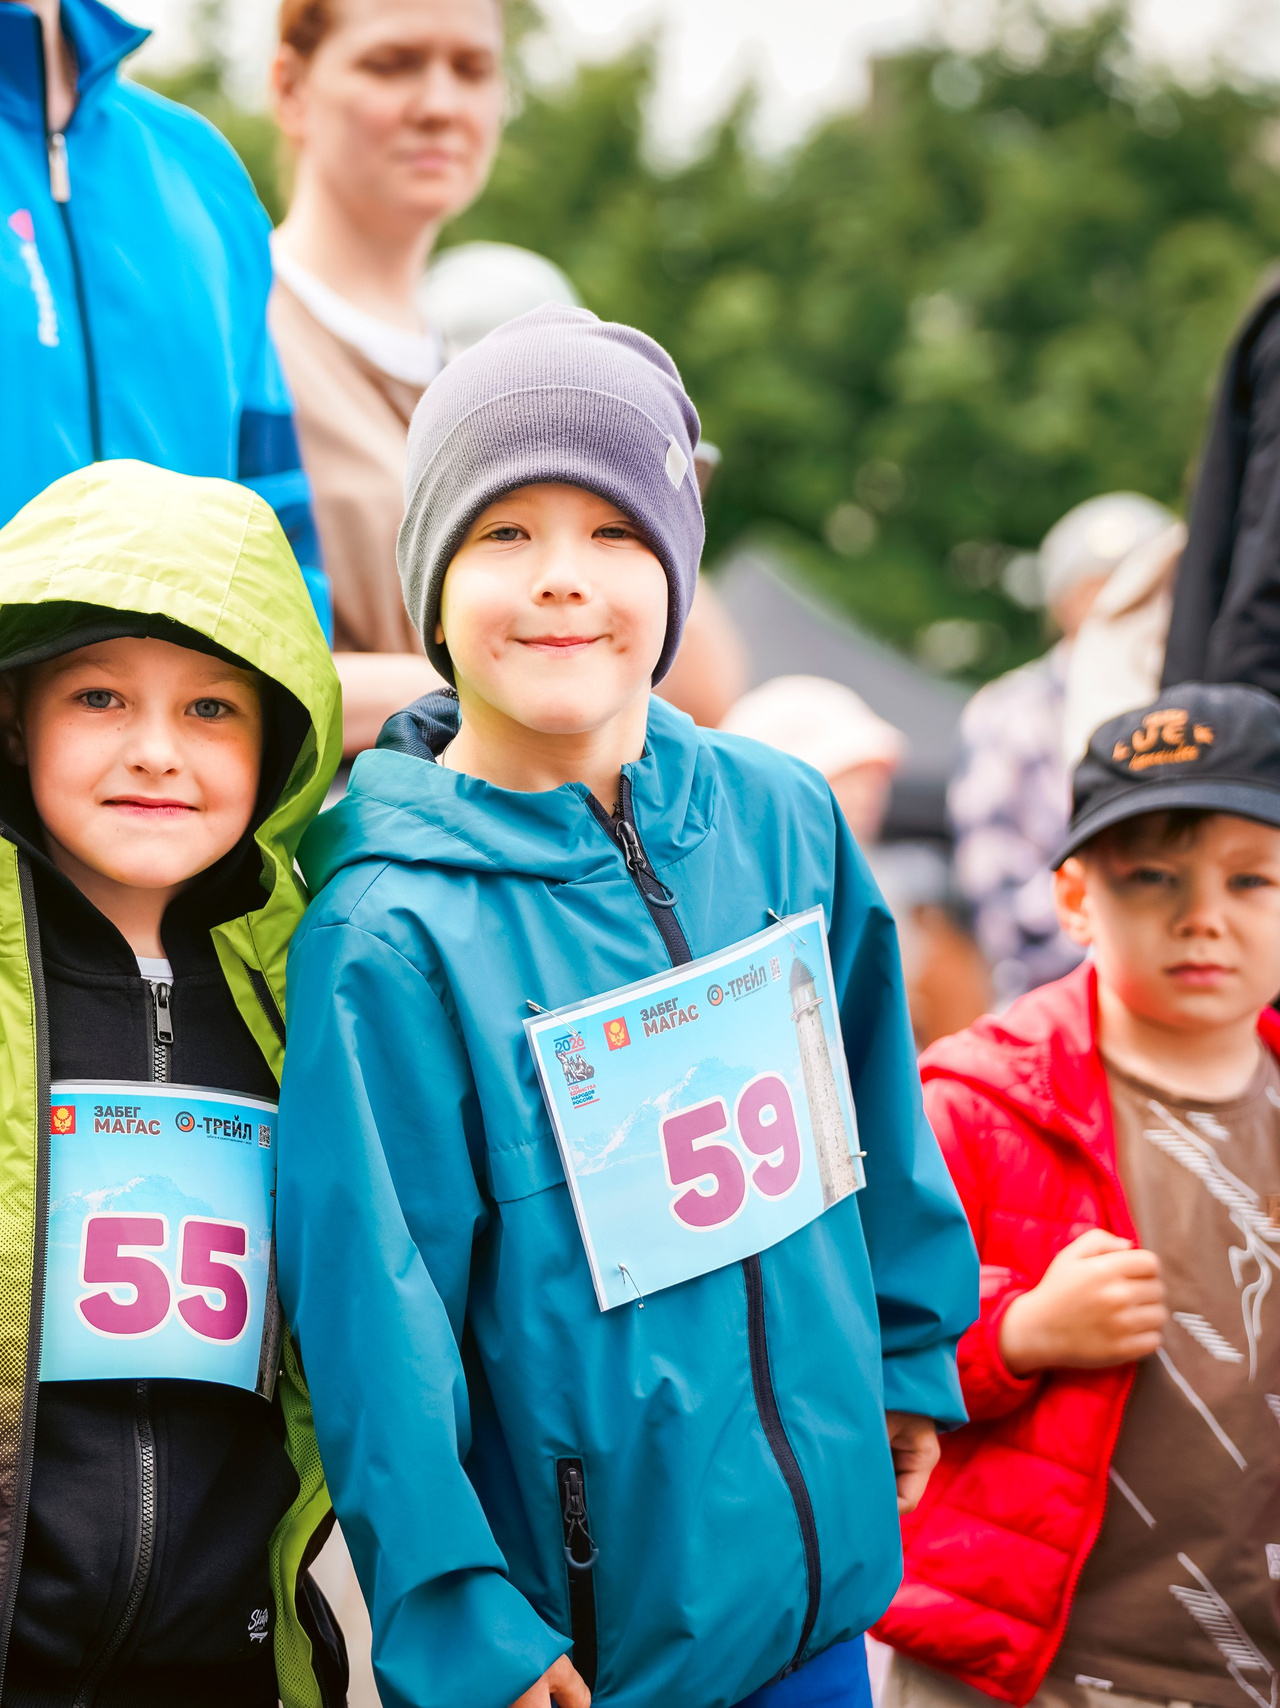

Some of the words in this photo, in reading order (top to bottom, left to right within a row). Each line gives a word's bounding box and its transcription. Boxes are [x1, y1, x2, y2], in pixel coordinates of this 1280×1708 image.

[640, 997, 678, 1022] ЗАБЕГ
[643, 1004, 699, 1038] МАГАС
[555, 1035, 584, 1053] 2026
[571, 1089, 595, 1101] НАРОДОВ
[572, 1095, 594, 1106] РОССИИ
[93, 1105, 141, 1118] ЗАБЕГ
[93, 1118, 161, 1136] МАГАС
[660, 1074, 803, 1231] 59
[77, 1214, 250, 1343] 55
